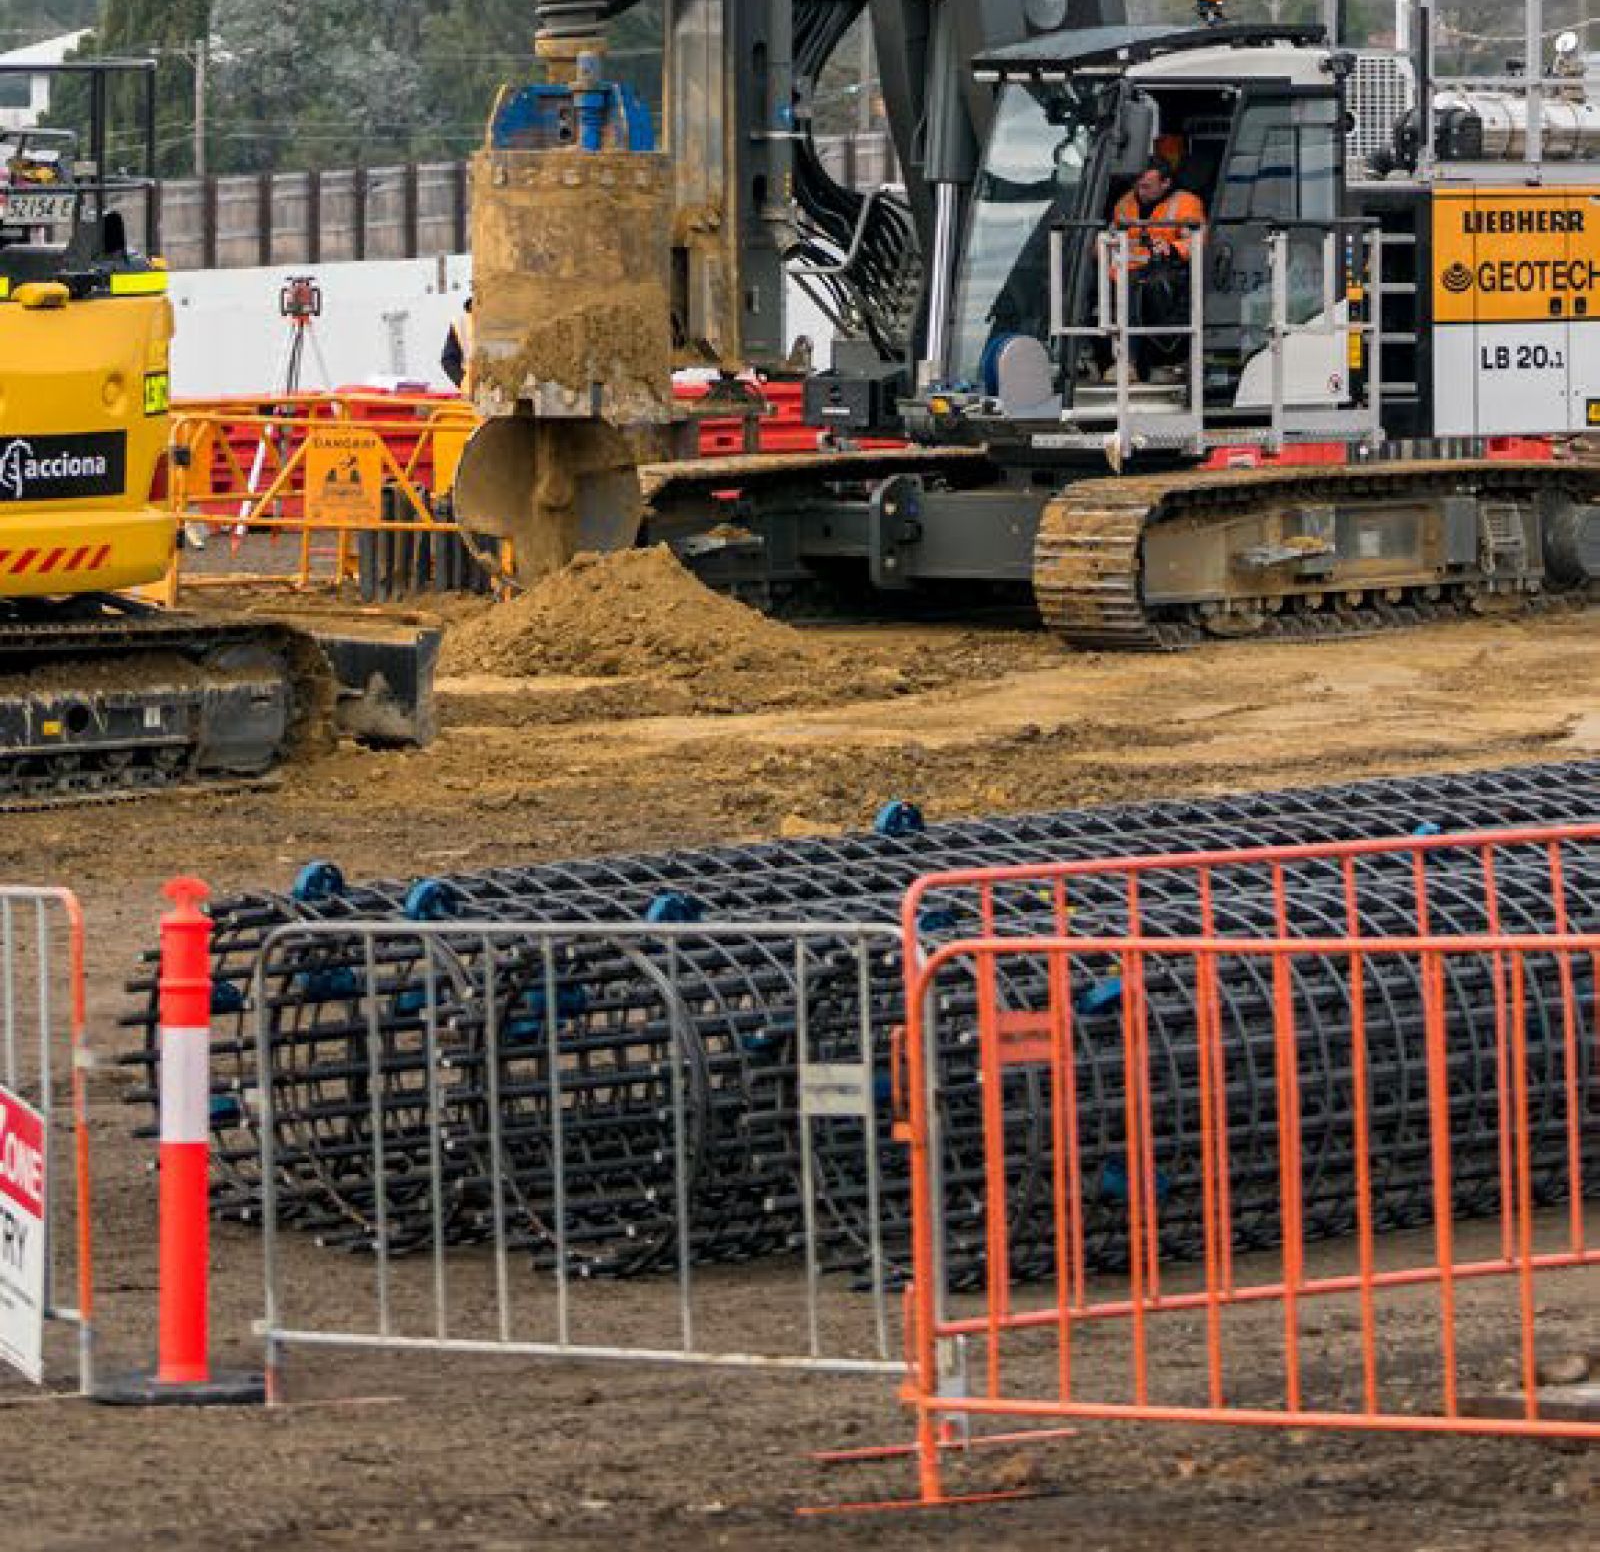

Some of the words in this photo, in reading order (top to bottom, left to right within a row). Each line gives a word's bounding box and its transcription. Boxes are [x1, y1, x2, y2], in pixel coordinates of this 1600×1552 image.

[1463, 210, 1585, 234] LIEBHERR
[1480, 345, 1510, 369] LB
[1516, 344, 1565, 369] 20.1
[24, 451, 106, 480] acciona
